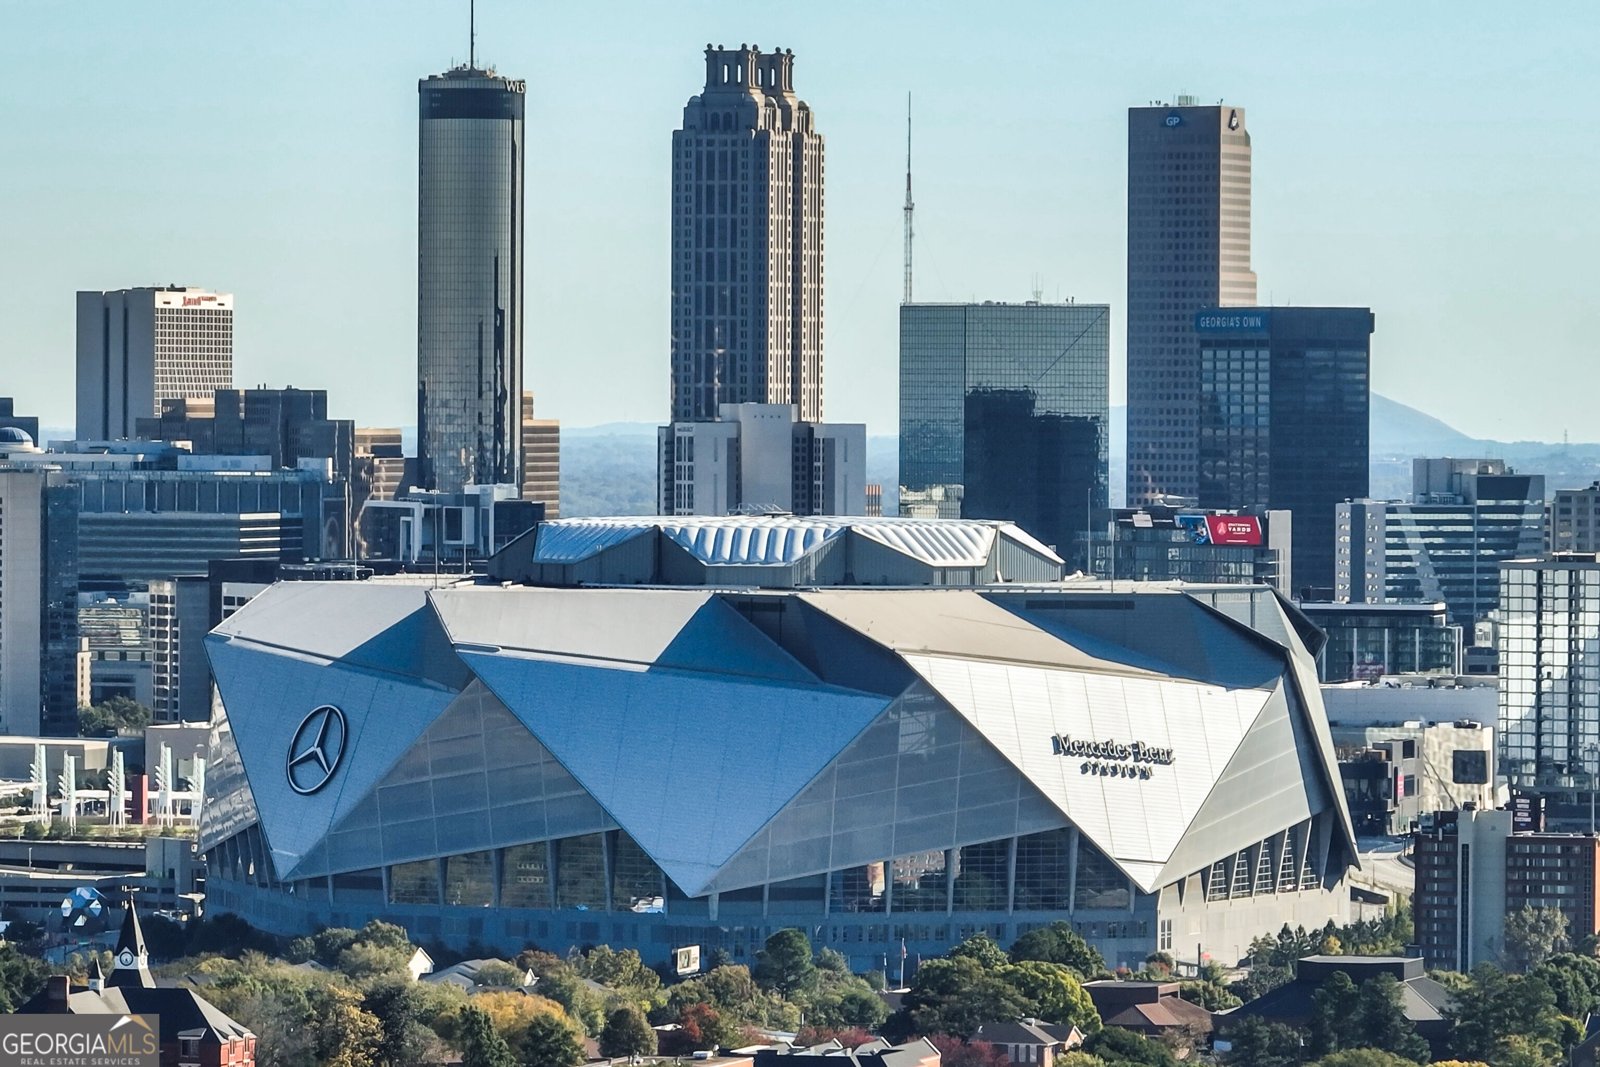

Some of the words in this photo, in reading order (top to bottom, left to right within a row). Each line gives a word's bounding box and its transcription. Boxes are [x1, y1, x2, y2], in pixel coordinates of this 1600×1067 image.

[1166, 117, 1180, 126] GP
[1200, 316, 1240, 328] GEORGIA'S
[1242, 316, 1261, 328] OWN
[1052, 733, 1176, 764] Mercedes-Benz
[1081, 761, 1154, 780] STADIUM
